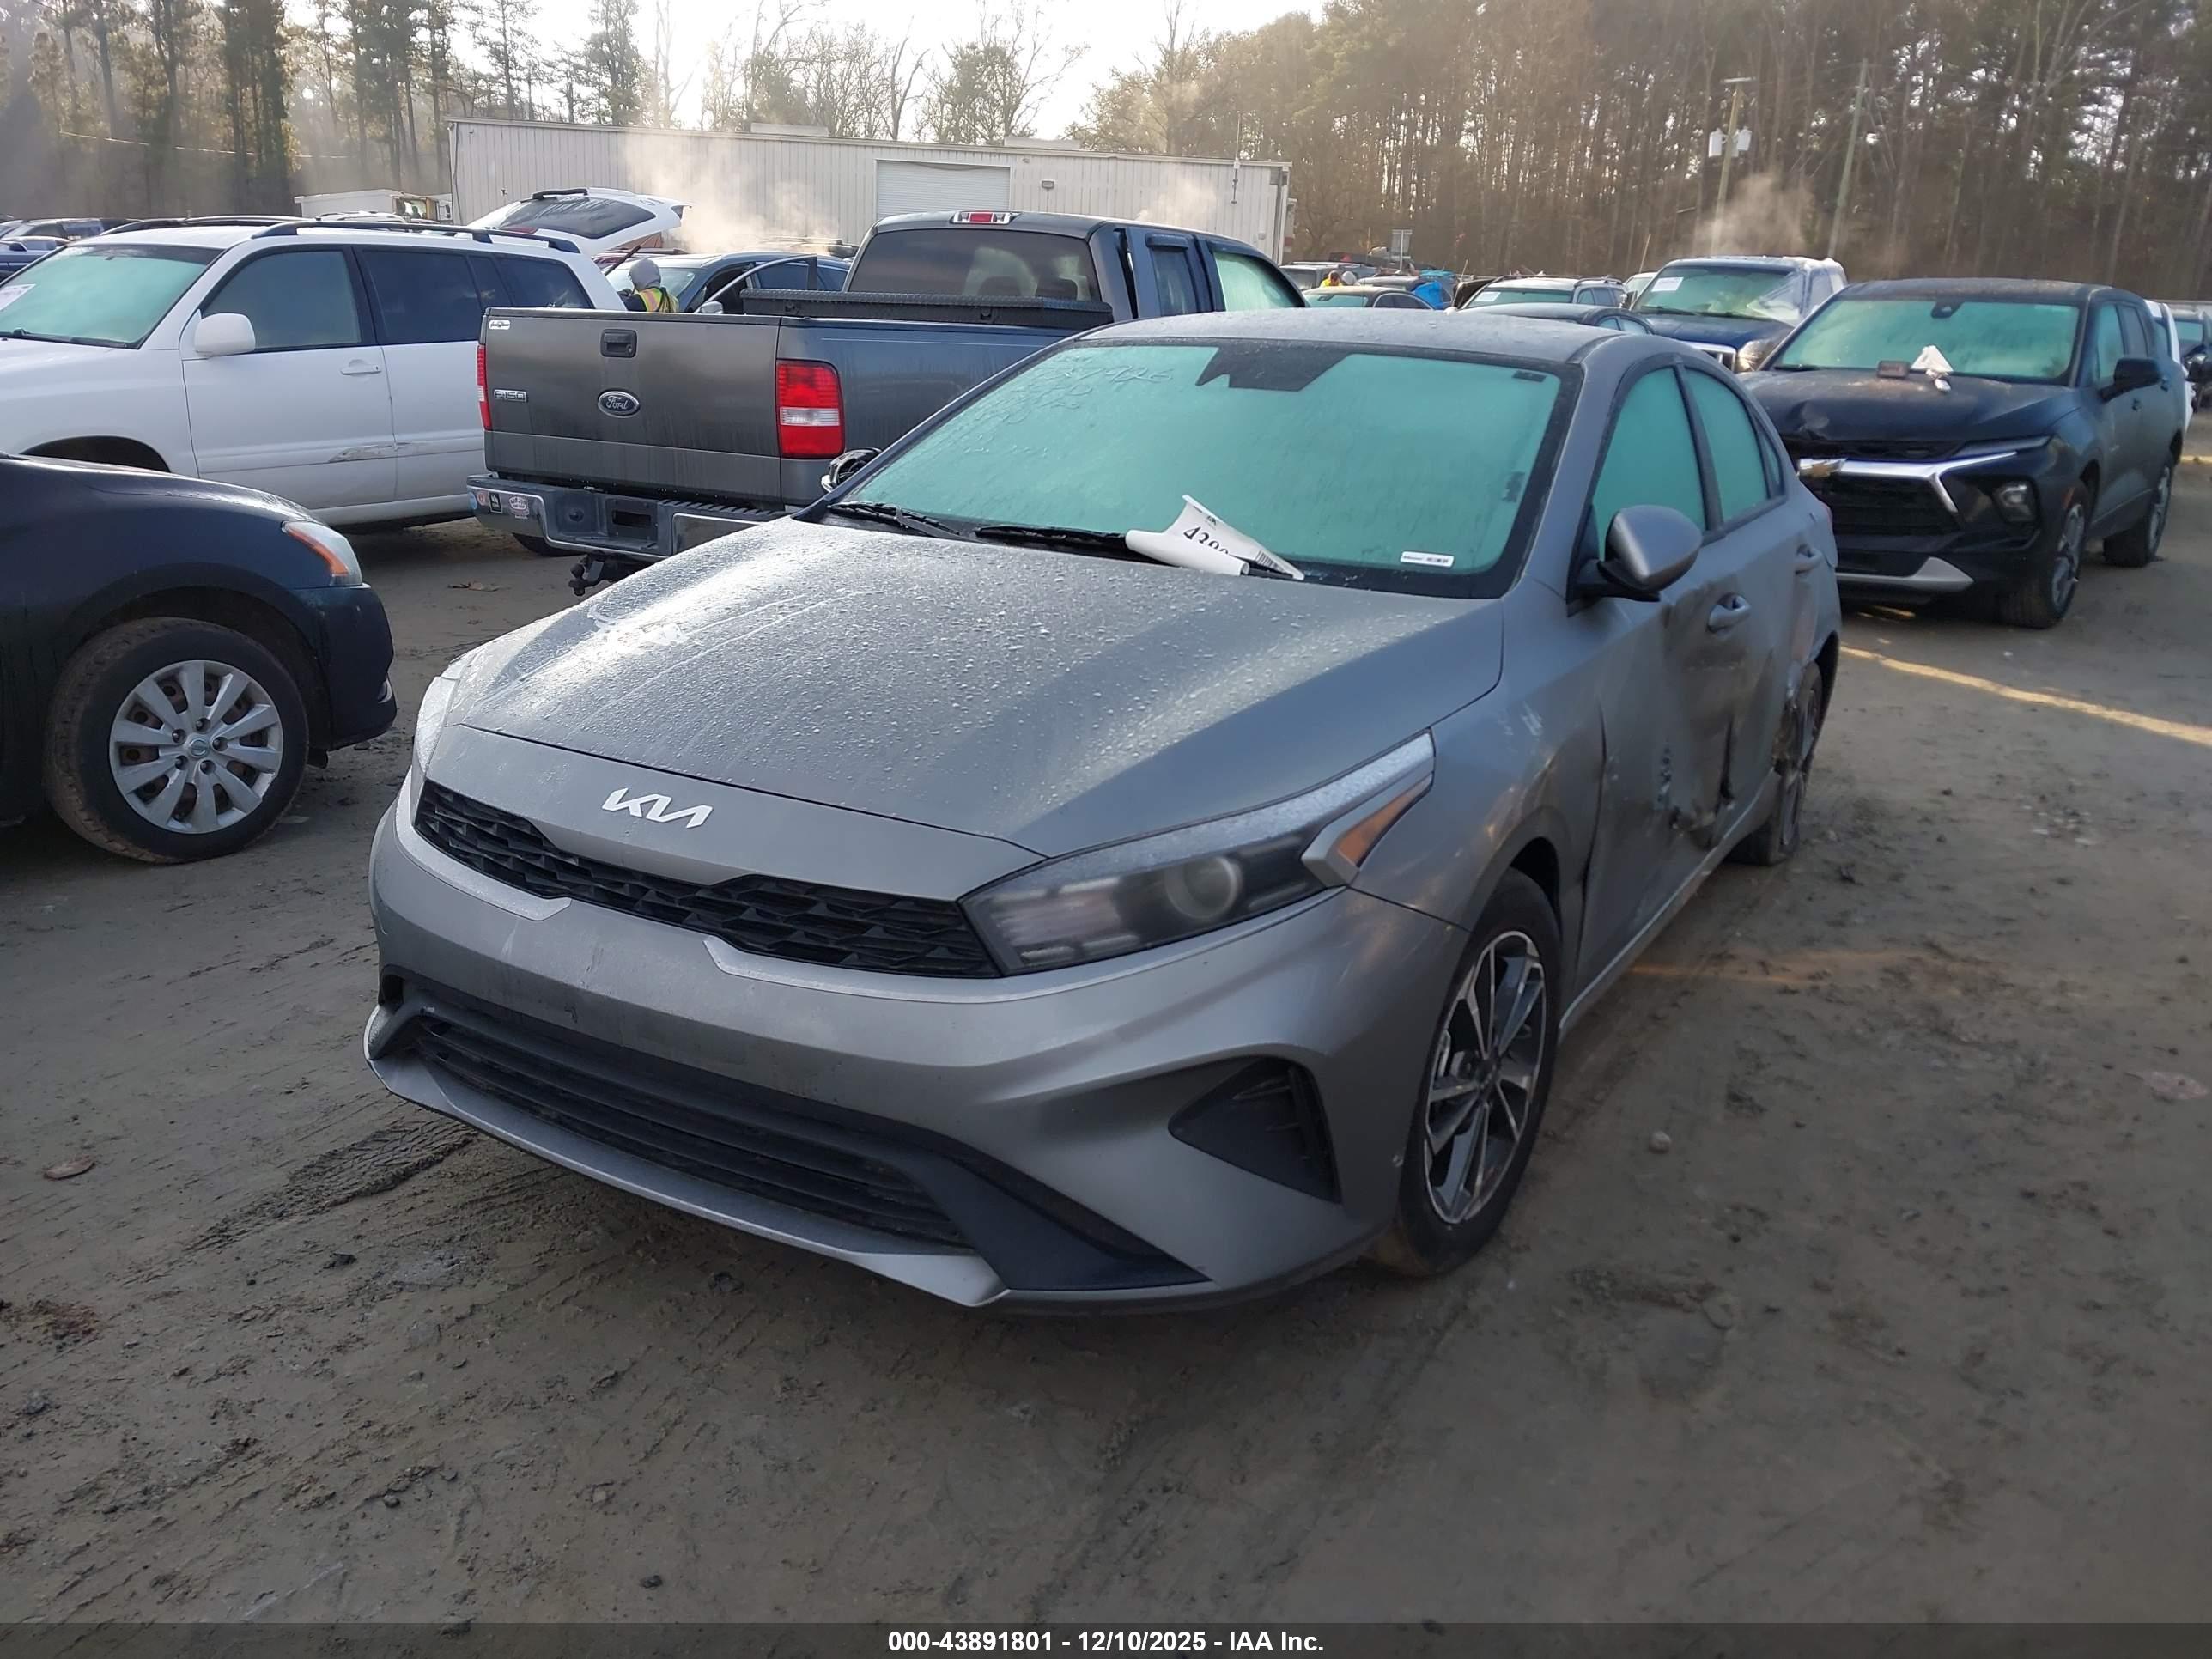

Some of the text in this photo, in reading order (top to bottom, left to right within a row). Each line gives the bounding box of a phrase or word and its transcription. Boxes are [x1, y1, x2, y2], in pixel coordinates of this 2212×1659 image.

[605, 395, 629, 410] Ford
[1183, 526, 1229, 555] 43
[602, 787, 714, 830] KIA
